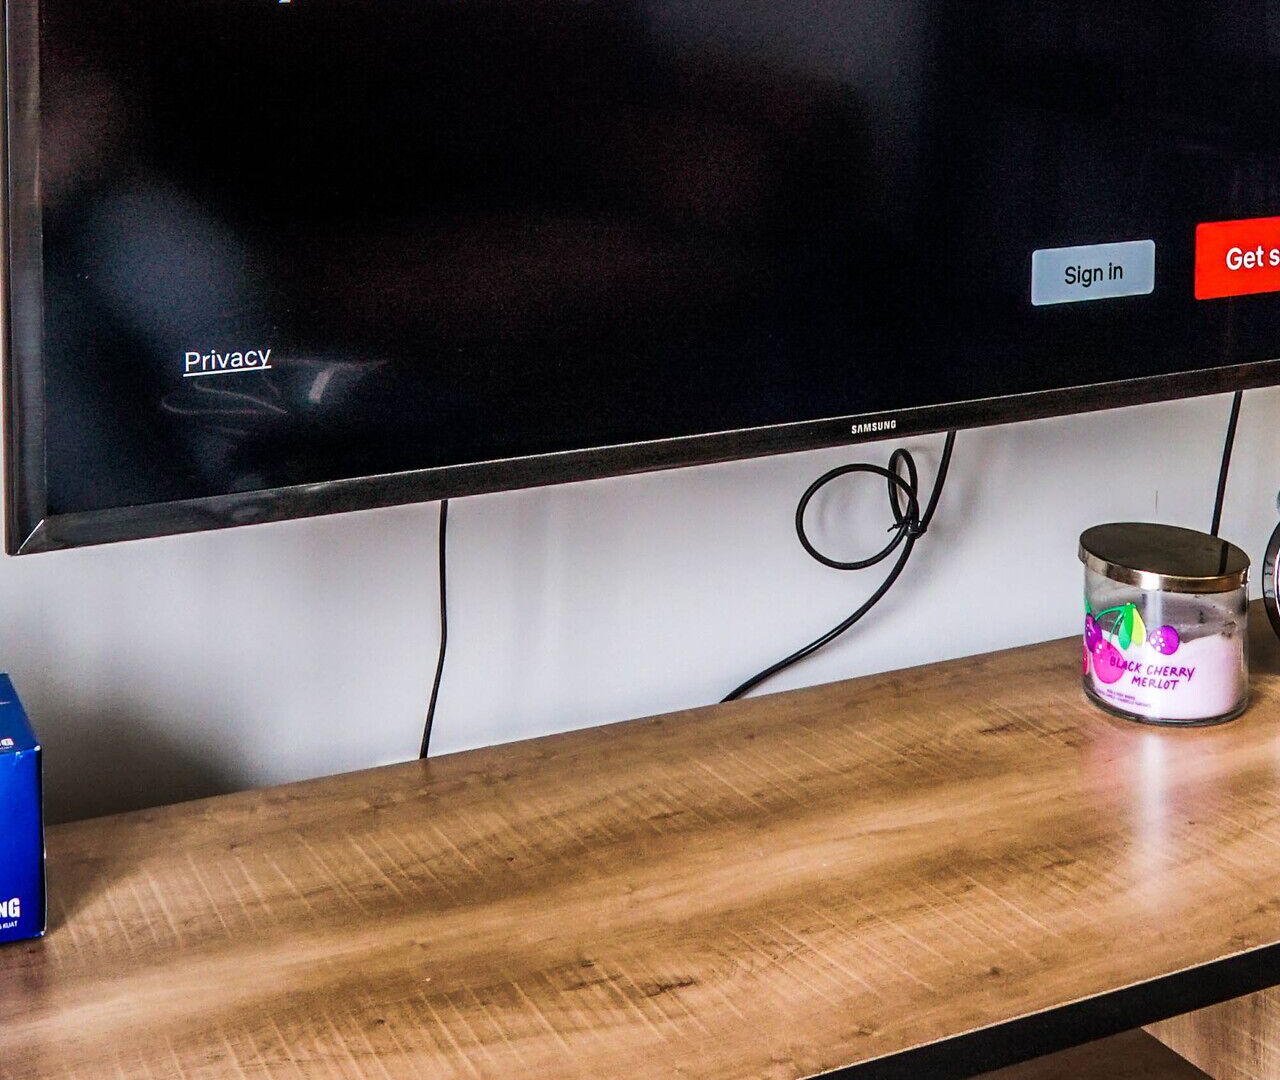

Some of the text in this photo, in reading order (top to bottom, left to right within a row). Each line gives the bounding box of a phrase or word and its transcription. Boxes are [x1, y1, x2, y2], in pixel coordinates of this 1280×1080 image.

[1226, 247, 1264, 271] Get
[1064, 262, 1123, 288] Sign in
[183, 348, 272, 374] Privacy
[851, 420, 897, 435] SAMSUNG
[1109, 656, 1196, 682] BLACK CHERRY
[1131, 675, 1180, 691] MERLOT
